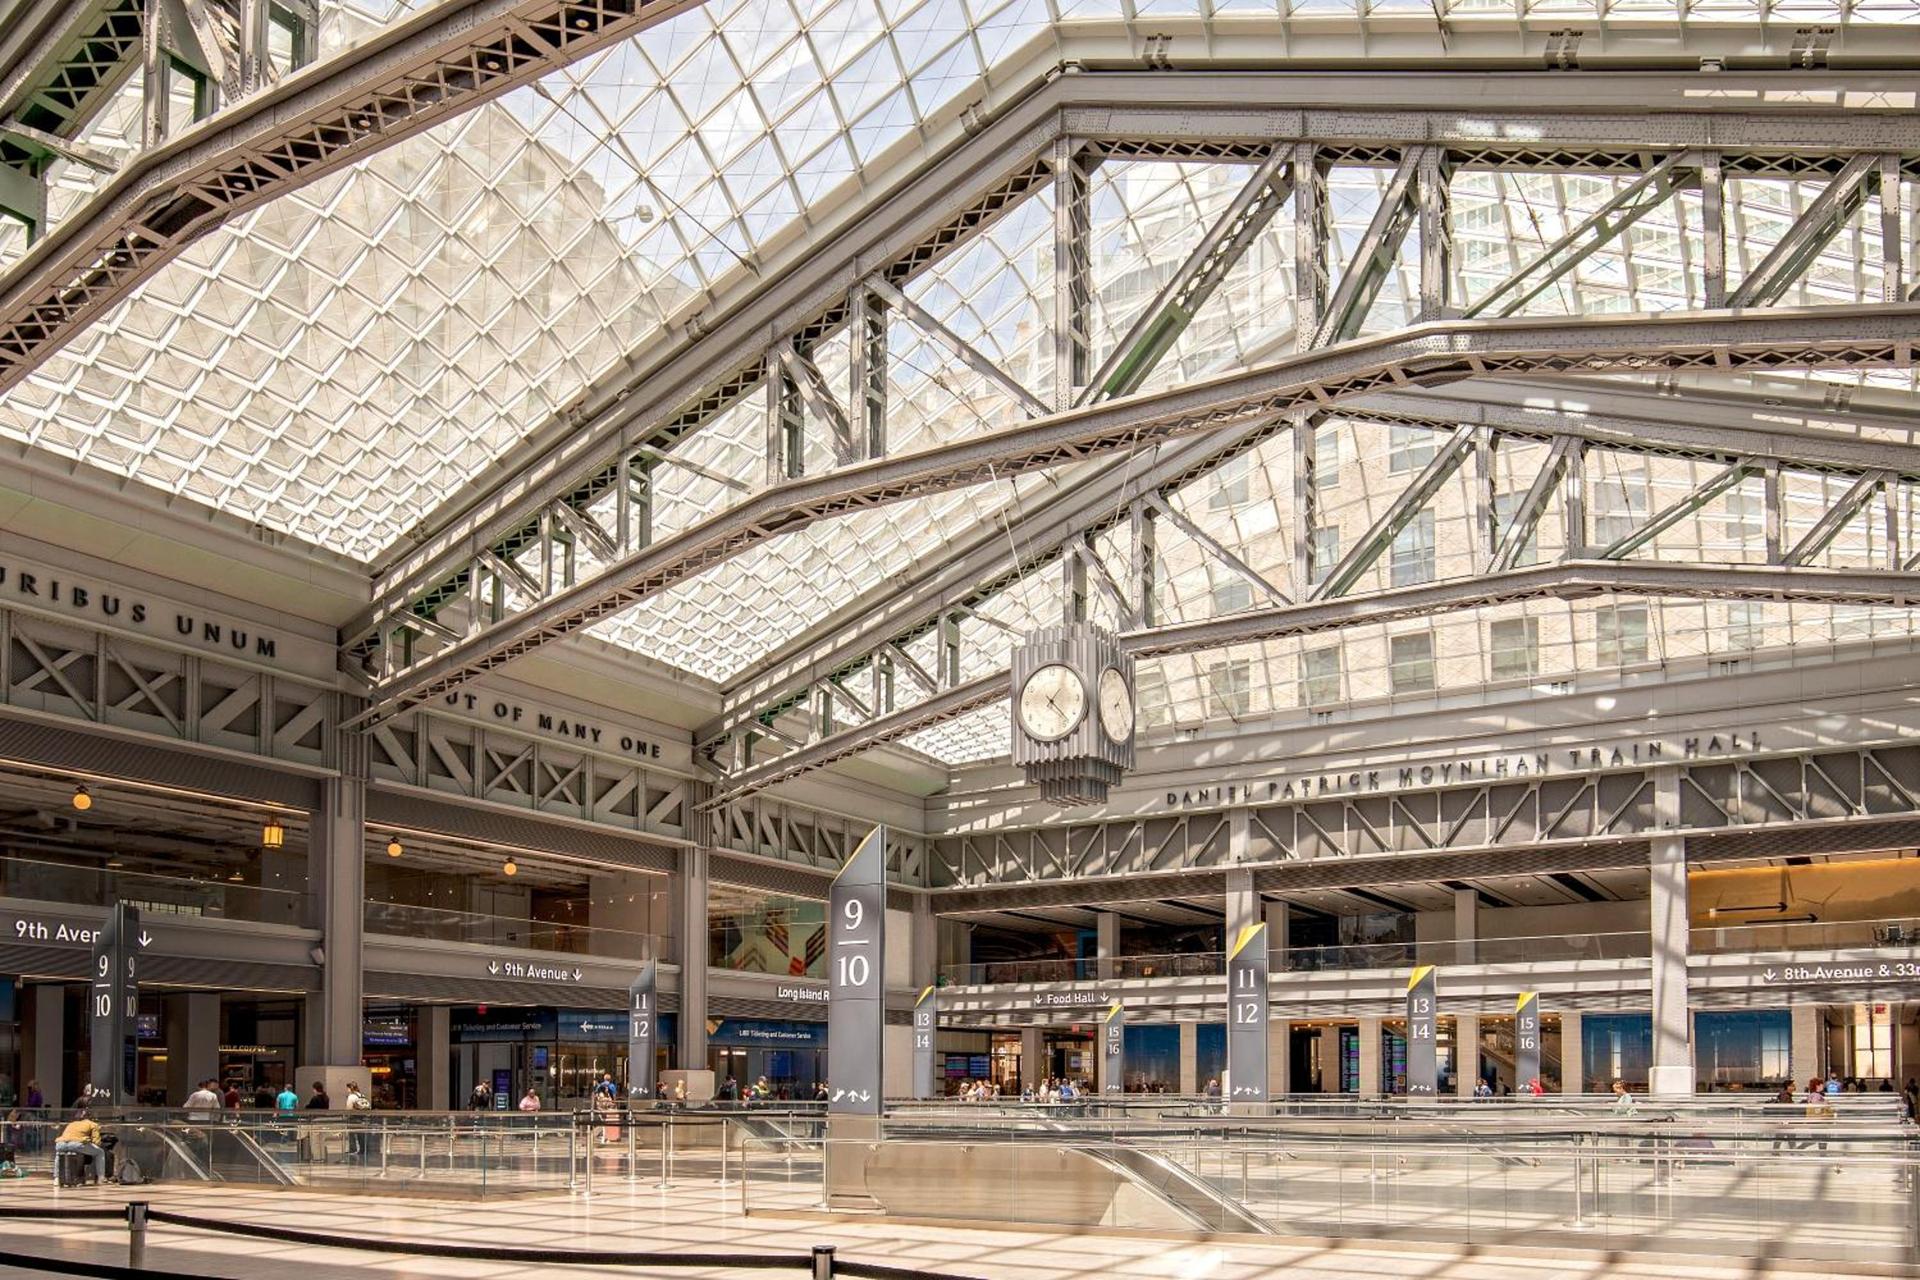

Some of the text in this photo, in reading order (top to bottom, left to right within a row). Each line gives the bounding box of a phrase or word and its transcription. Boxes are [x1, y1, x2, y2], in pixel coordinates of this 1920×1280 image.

[177, 615, 276, 658] UNUM
[494, 703, 522, 722] OF
[538, 713, 602, 744] MANY
[621, 736, 661, 759] ONE
[1167, 731, 1762, 806] DANIEL PATRICK MOYNIHAN TRAIN HALL
[844, 899, 864, 930] 9
[15, 920, 48, 940] 9th
[99, 954, 109, 978] 9
[128, 956, 135, 978] 9
[504, 962, 568, 981] 9th Avenue
[838, 955, 870, 987] 10
[1784, 967, 1810, 981] 8th
[1814, 966, 1873, 980] Avenue
[1878, 964, 1890, 977] &
[1239, 968, 1256, 989] 11
[634, 993, 648, 1009] 11
[778, 986, 798, 1001] Long
[799, 988, 822, 1001] Island
[1047, 992, 1095, 1004] Food Hall
[95, 994, 111, 1017] 10
[126, 995, 136, 1018] 10
[1237, 1003, 1258, 1024] 12
[1413, 999, 1429, 1014] 13
[917, 1013, 930, 1026] 13
[1520, 1017, 1534, 1030] 15
[633, 1020, 649, 1038] 12
[1109, 1026, 1119, 1037] 15
[1412, 1024, 1430, 1039] 14
[917, 1035, 930, 1048] 14
[1109, 1044, 1120, 1054] 16
[1520, 1037, 1534, 1049] 16
